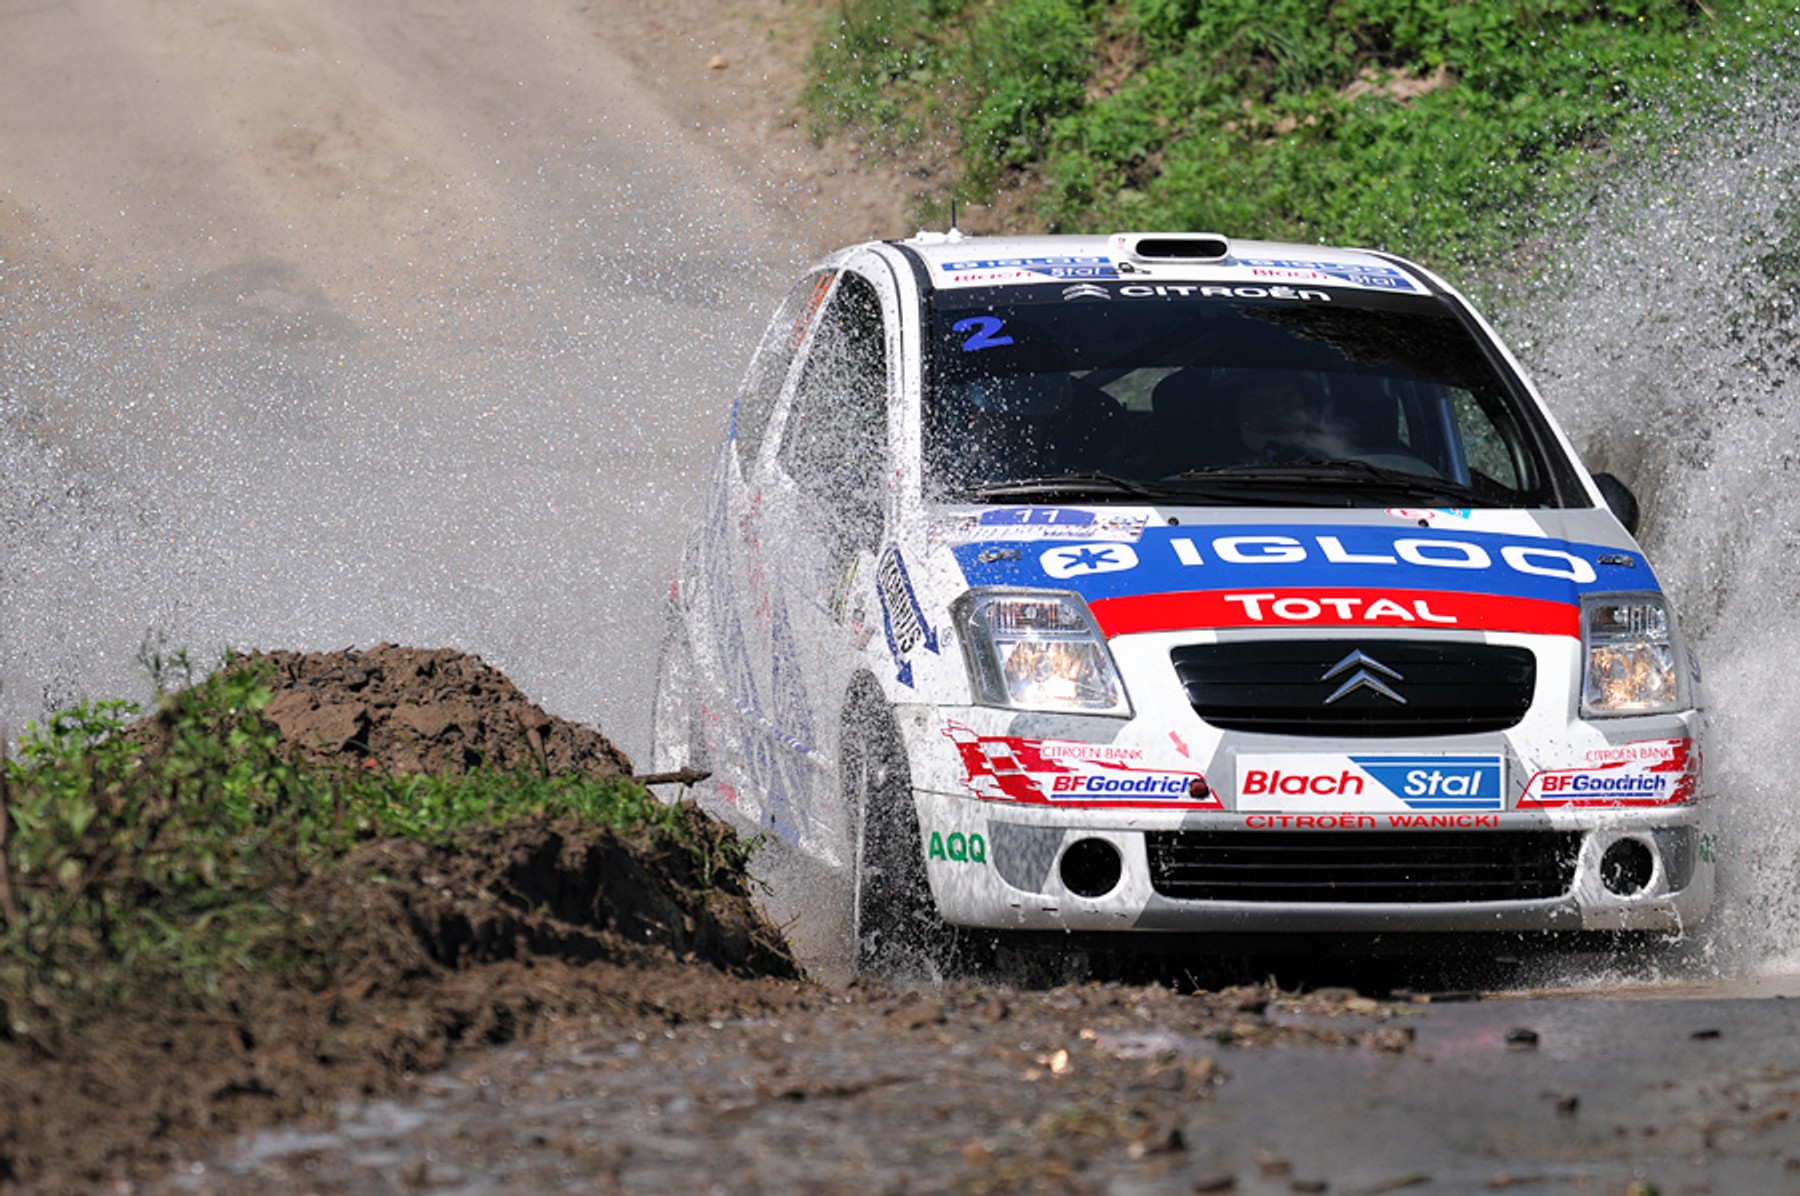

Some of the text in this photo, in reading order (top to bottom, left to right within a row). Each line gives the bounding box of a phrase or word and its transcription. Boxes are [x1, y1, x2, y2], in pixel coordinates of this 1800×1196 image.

[1051, 267, 1100, 279] Stal
[1252, 267, 1328, 280] Blach
[952, 315, 1014, 351] 2
[1170, 536, 1597, 583] IGLOO
[1105, 746, 1143, 760] BANK
[1640, 746, 1672, 758] BANK
[1242, 770, 1482, 797] Blach Stal
[1541, 774, 1666, 793] BFGoodrich
[1389, 815, 1500, 829] WANICKI
[929, 831, 987, 864] AQQ
